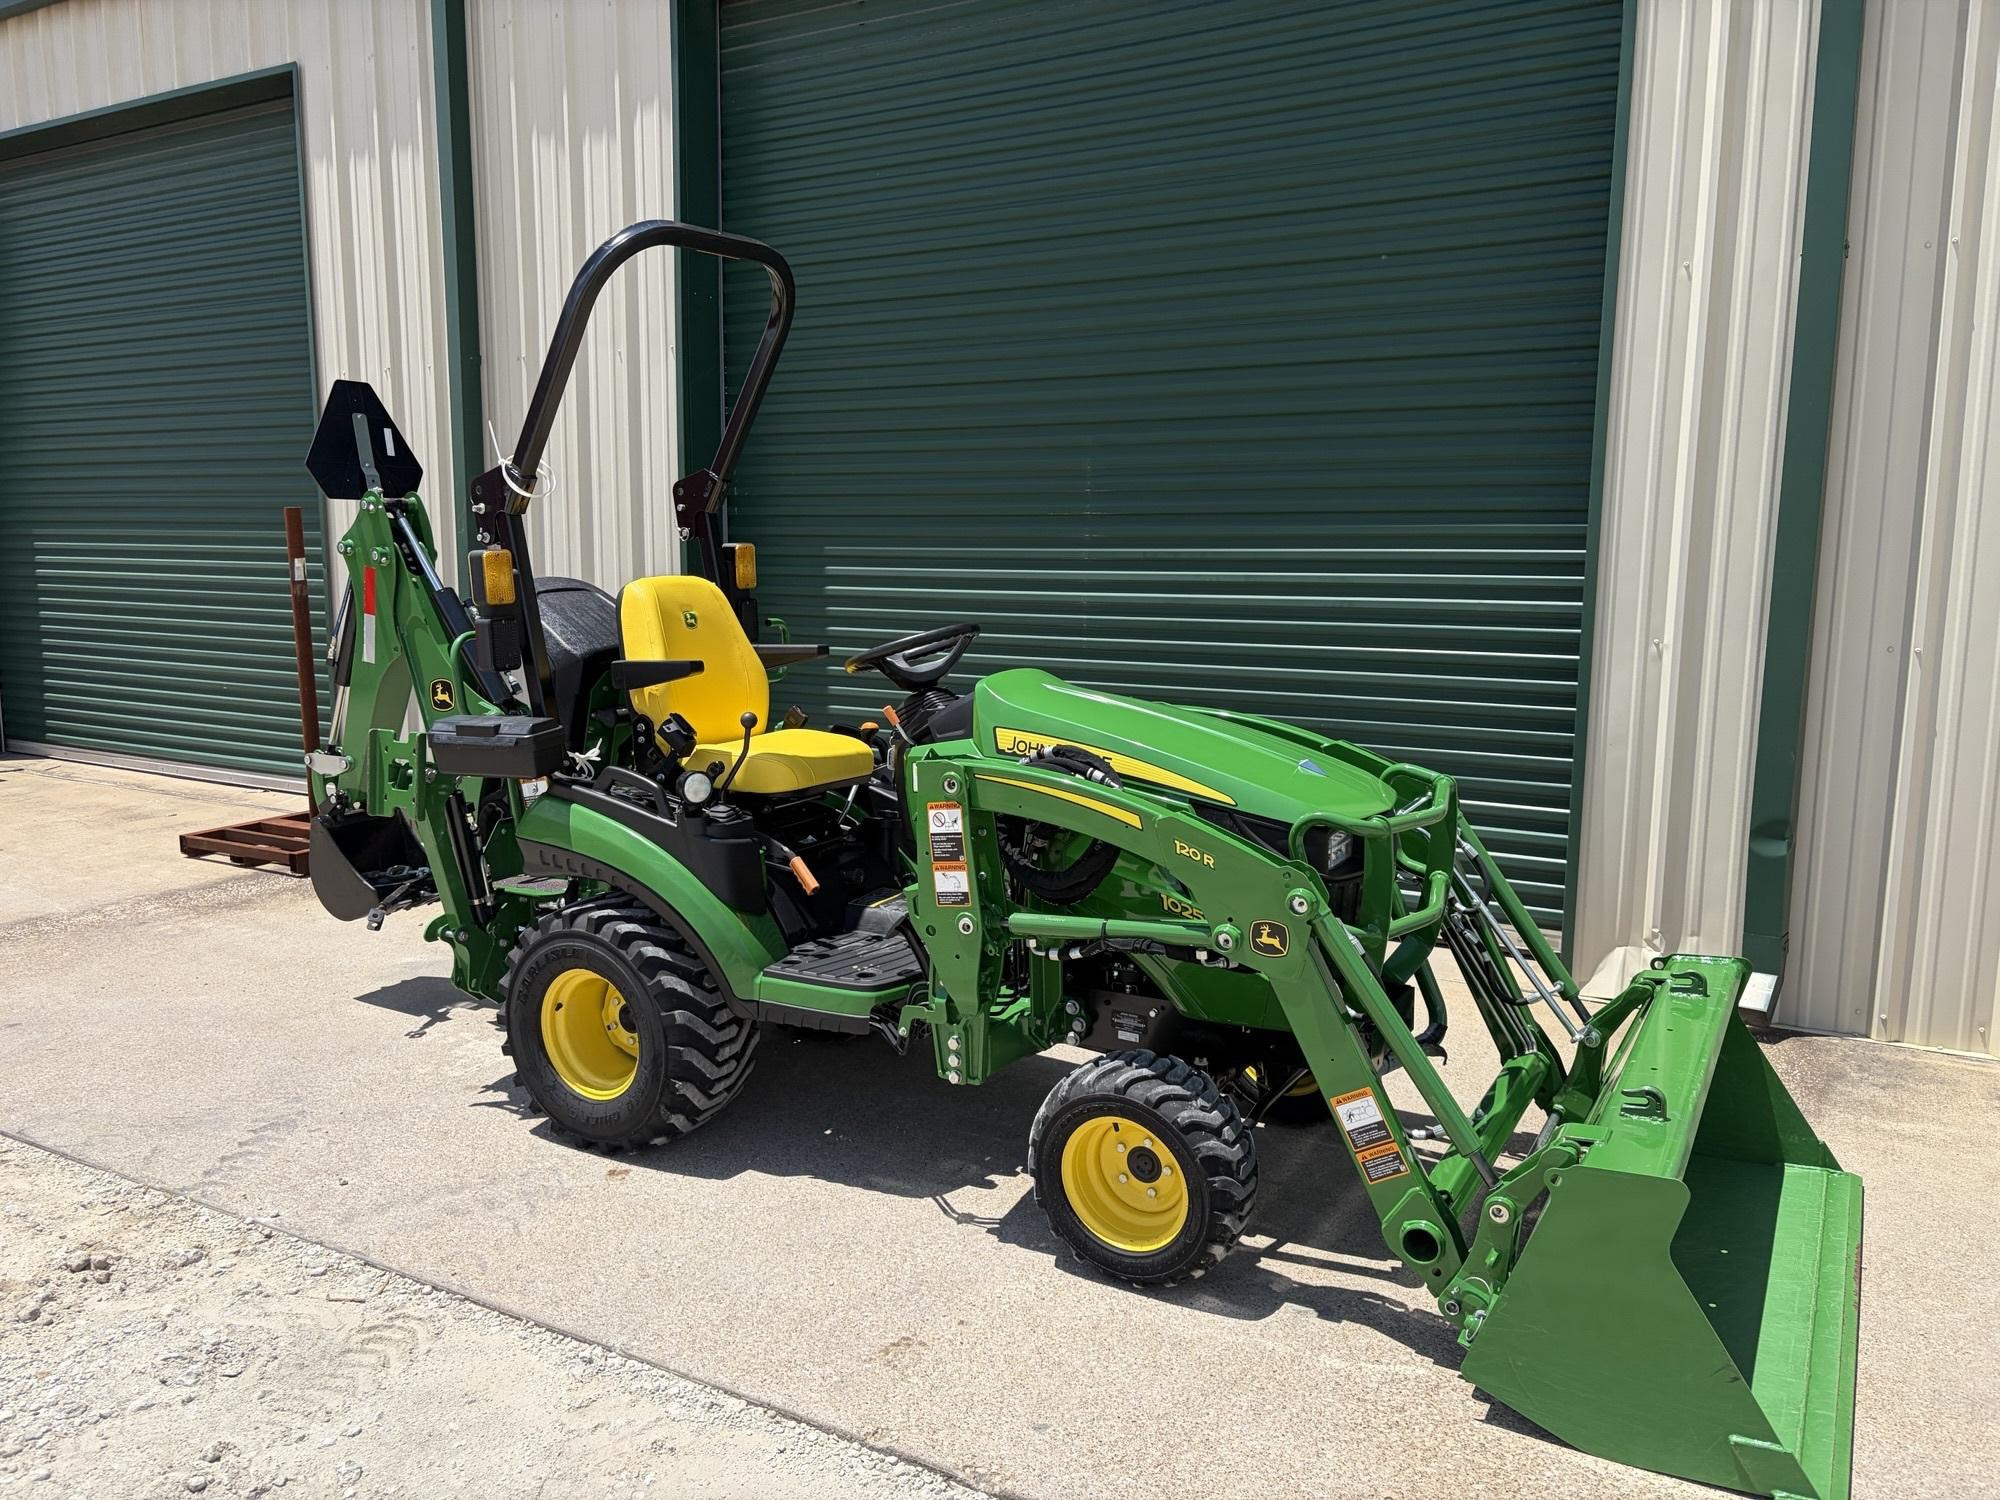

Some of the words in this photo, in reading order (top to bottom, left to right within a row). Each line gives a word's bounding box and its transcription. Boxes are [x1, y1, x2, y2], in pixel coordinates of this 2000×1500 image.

[1174, 839, 1201, 861] 120
[1203, 853, 1215, 869] R
[1342, 1090, 1368, 1103] WARNING
[1368, 1146, 1395, 1158] WARNING
